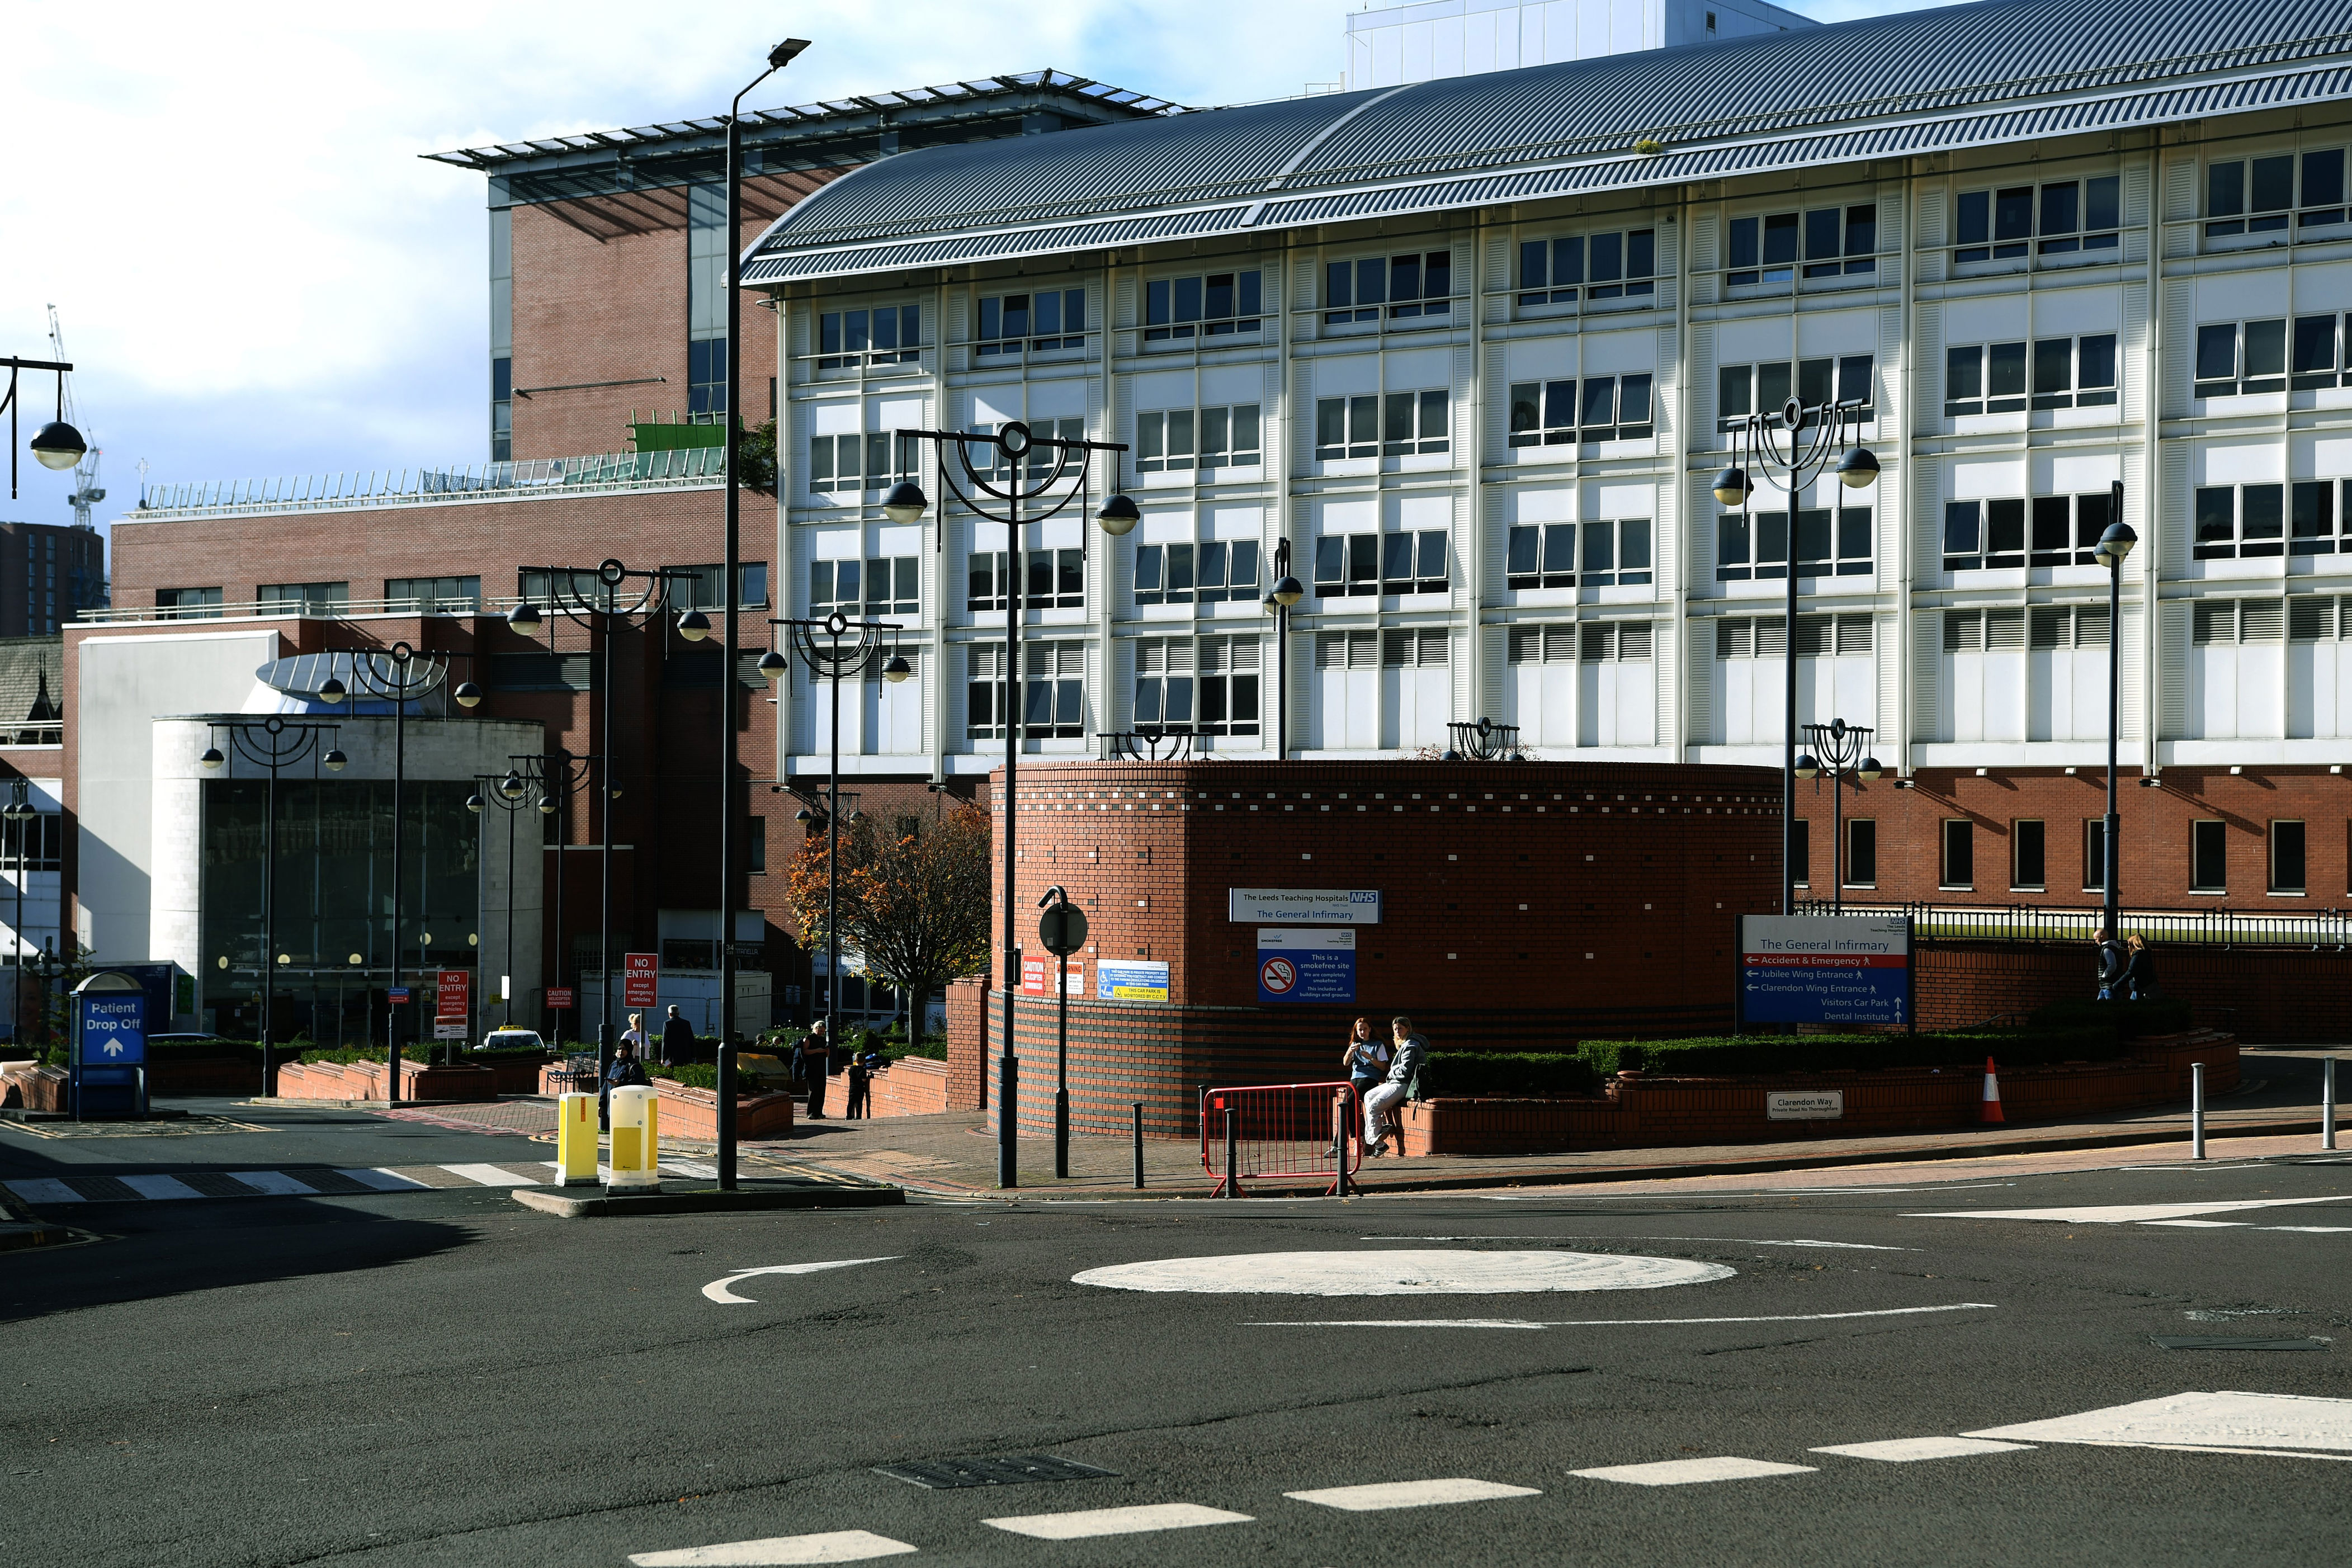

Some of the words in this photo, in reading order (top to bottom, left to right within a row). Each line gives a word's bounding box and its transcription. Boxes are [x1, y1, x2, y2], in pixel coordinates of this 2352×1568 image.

[1350, 892, 1376, 903] NHS
[1312, 911, 1353, 920] Infirmary
[1760, 939, 1782, 950] The
[1786, 939, 1830, 950] General
[1835, 939, 1889, 953] Infirmary
[635, 958, 649, 967] NO
[1761, 956, 1800, 965] Accident
[1811, 957, 1860, 966] Emergency
[1024, 961, 1044, 972] CAUTION
[626, 970, 657, 979] ENTRY
[1792, 970, 1814, 980] Wing
[1761, 984, 1803, 992] Clarendon
[1806, 984, 1828, 994] Wing
[1830, 985, 1868, 993] Entrance
[1821, 998, 1852, 1007] Visitors
[1854, 999, 1868, 1007] Car
[1871, 999, 1889, 1007] Park
[92, 1003, 136, 1014] Patient
[1825, 1012, 1852, 1021] Dental
[1854, 1012, 1890, 1021] Institute
[86, 1019, 117, 1032] Drop
[121, 1018, 140, 1029] Off
